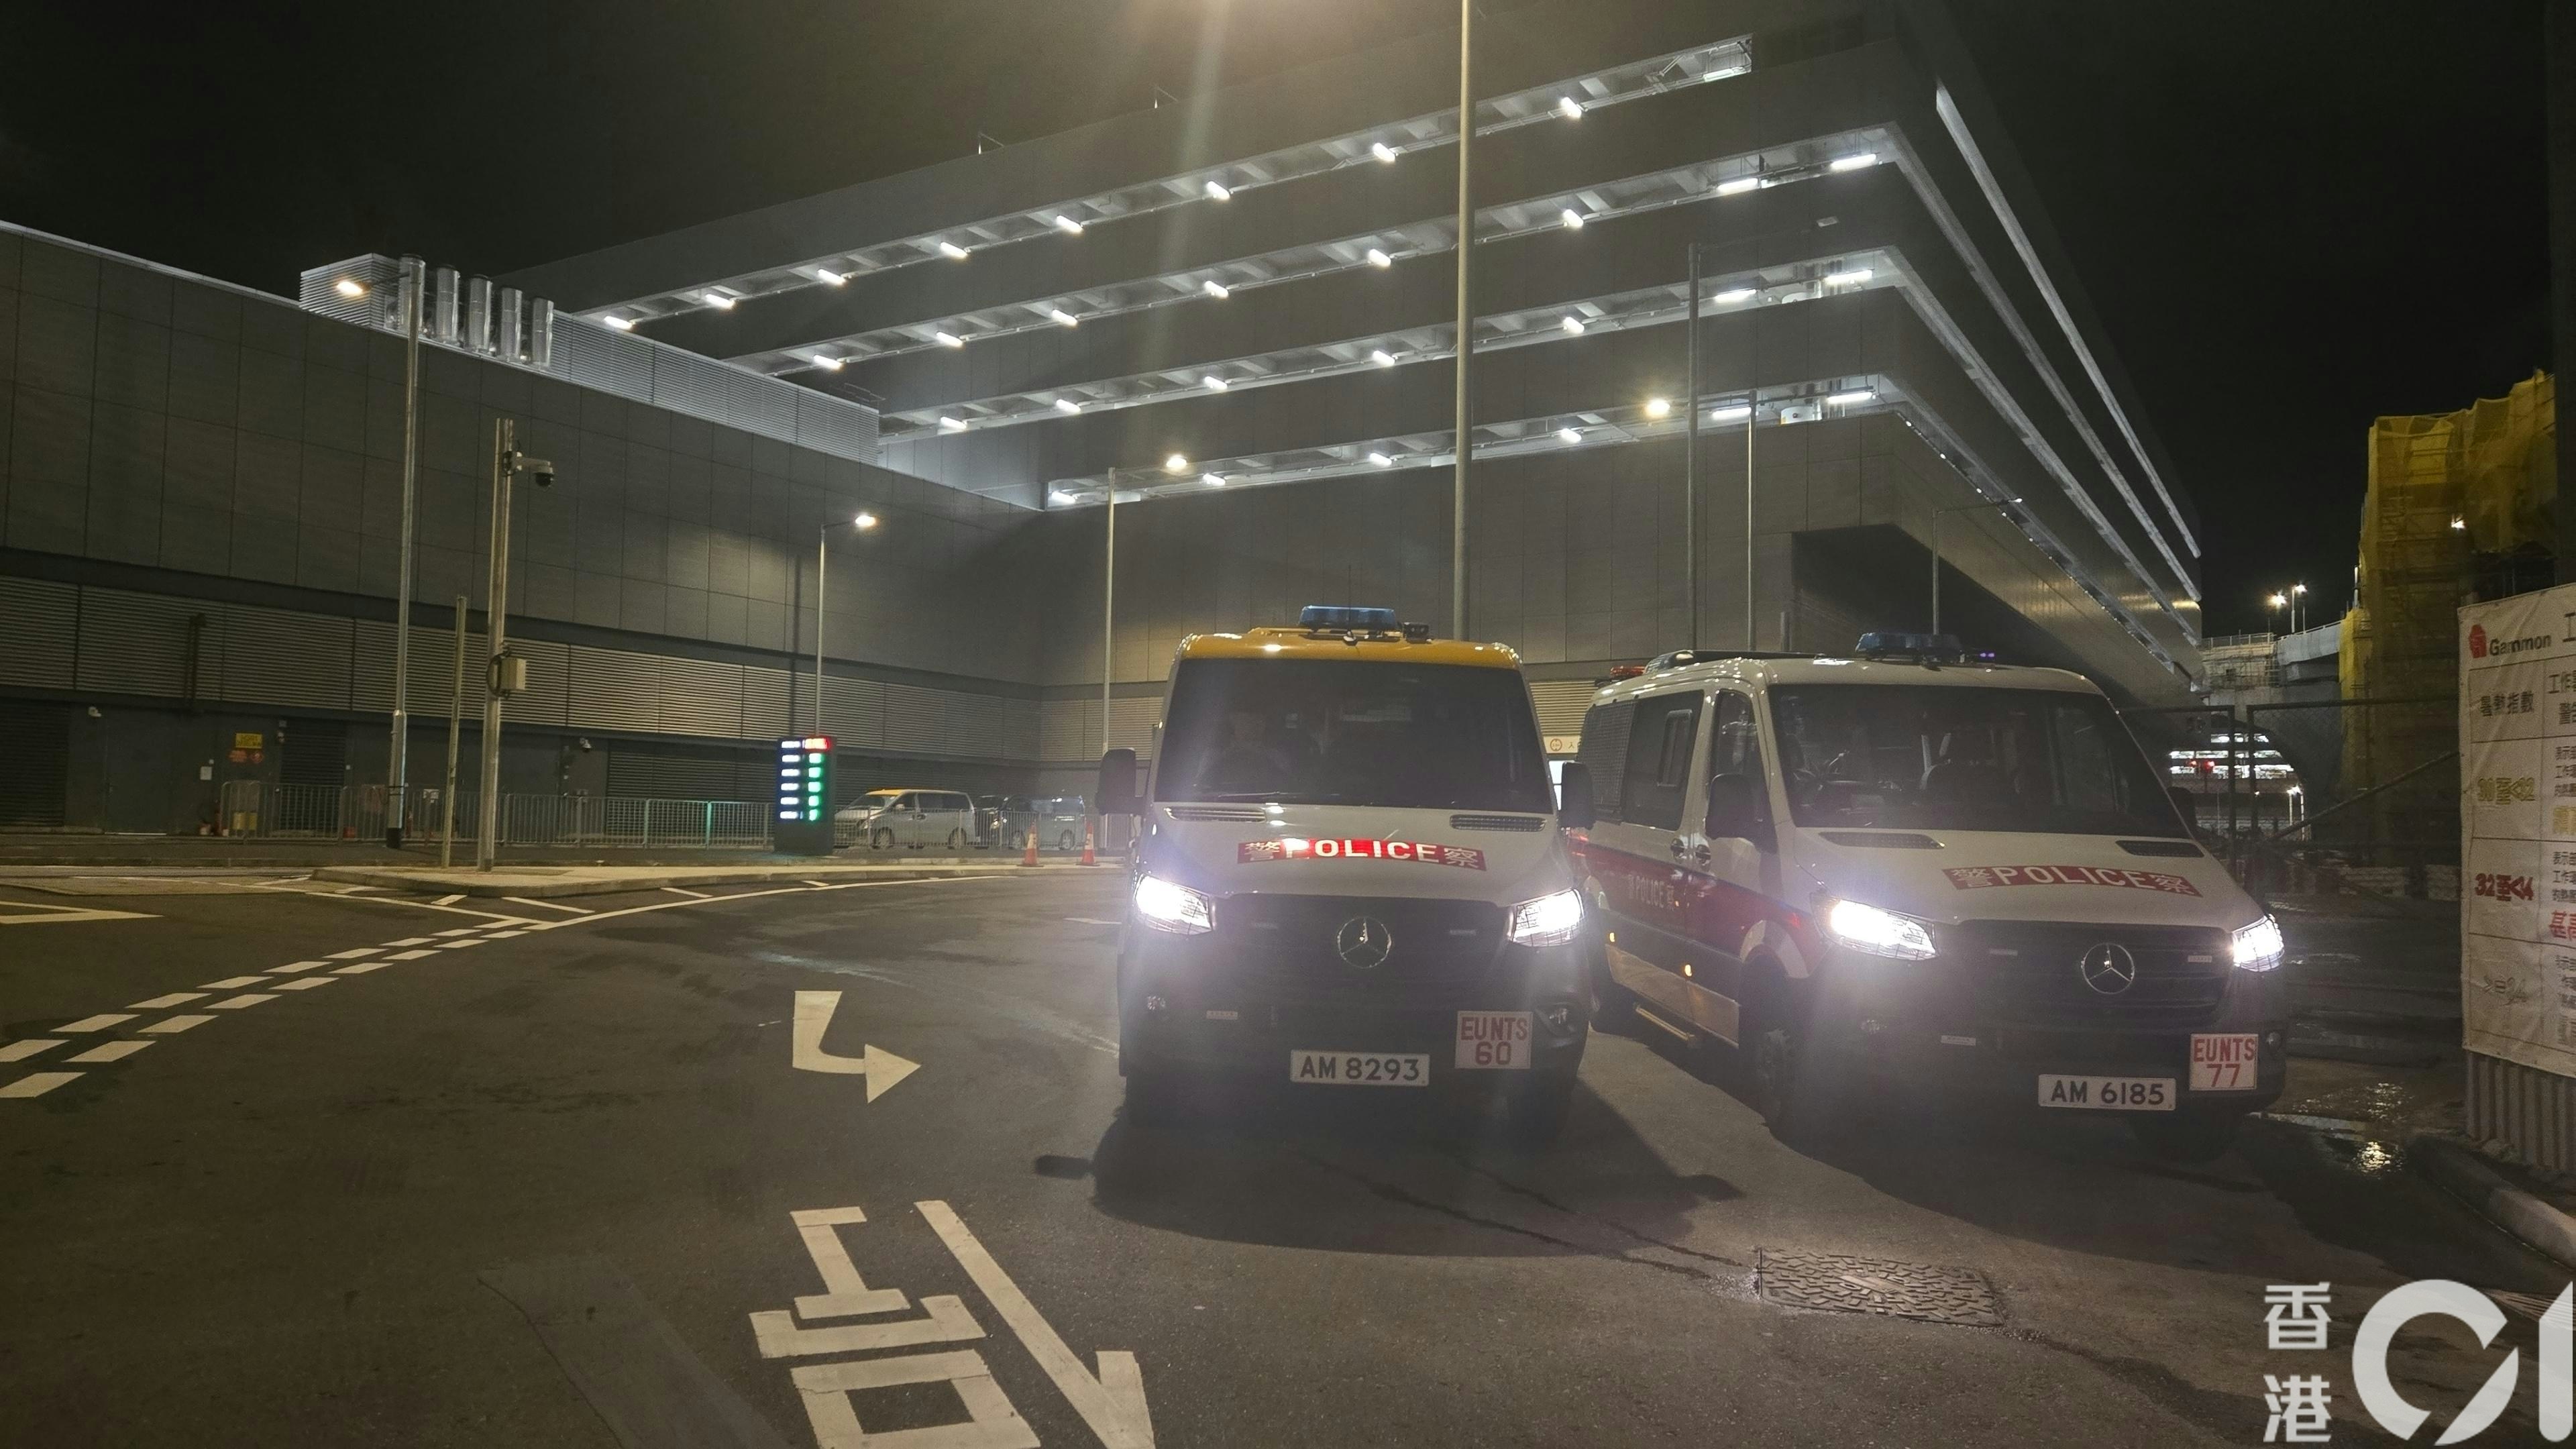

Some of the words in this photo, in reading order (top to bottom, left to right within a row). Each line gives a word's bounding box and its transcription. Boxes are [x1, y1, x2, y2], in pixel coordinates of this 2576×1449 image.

[2489, 635, 2552, 656] Gammon
[1245, 841, 1280, 861] 警
[1282, 838, 1440, 863] POLICE
[1444, 848, 1479, 868] 察
[1636, 875, 1664, 908] POLICE
[1953, 868, 1992, 887] 警
[1994, 866, 2157, 890] POLICE
[2149, 874, 2195, 894] 察
[1475, 1041, 1512, 1065] 60
[1299, 1056, 1336, 1079] AM
[1346, 1057, 1419, 1081] 8293
[2206, 1063, 2241, 1087] 77
[2051, 1080, 2088, 1104] AM
[2101, 1082, 2164, 1106] 6185
